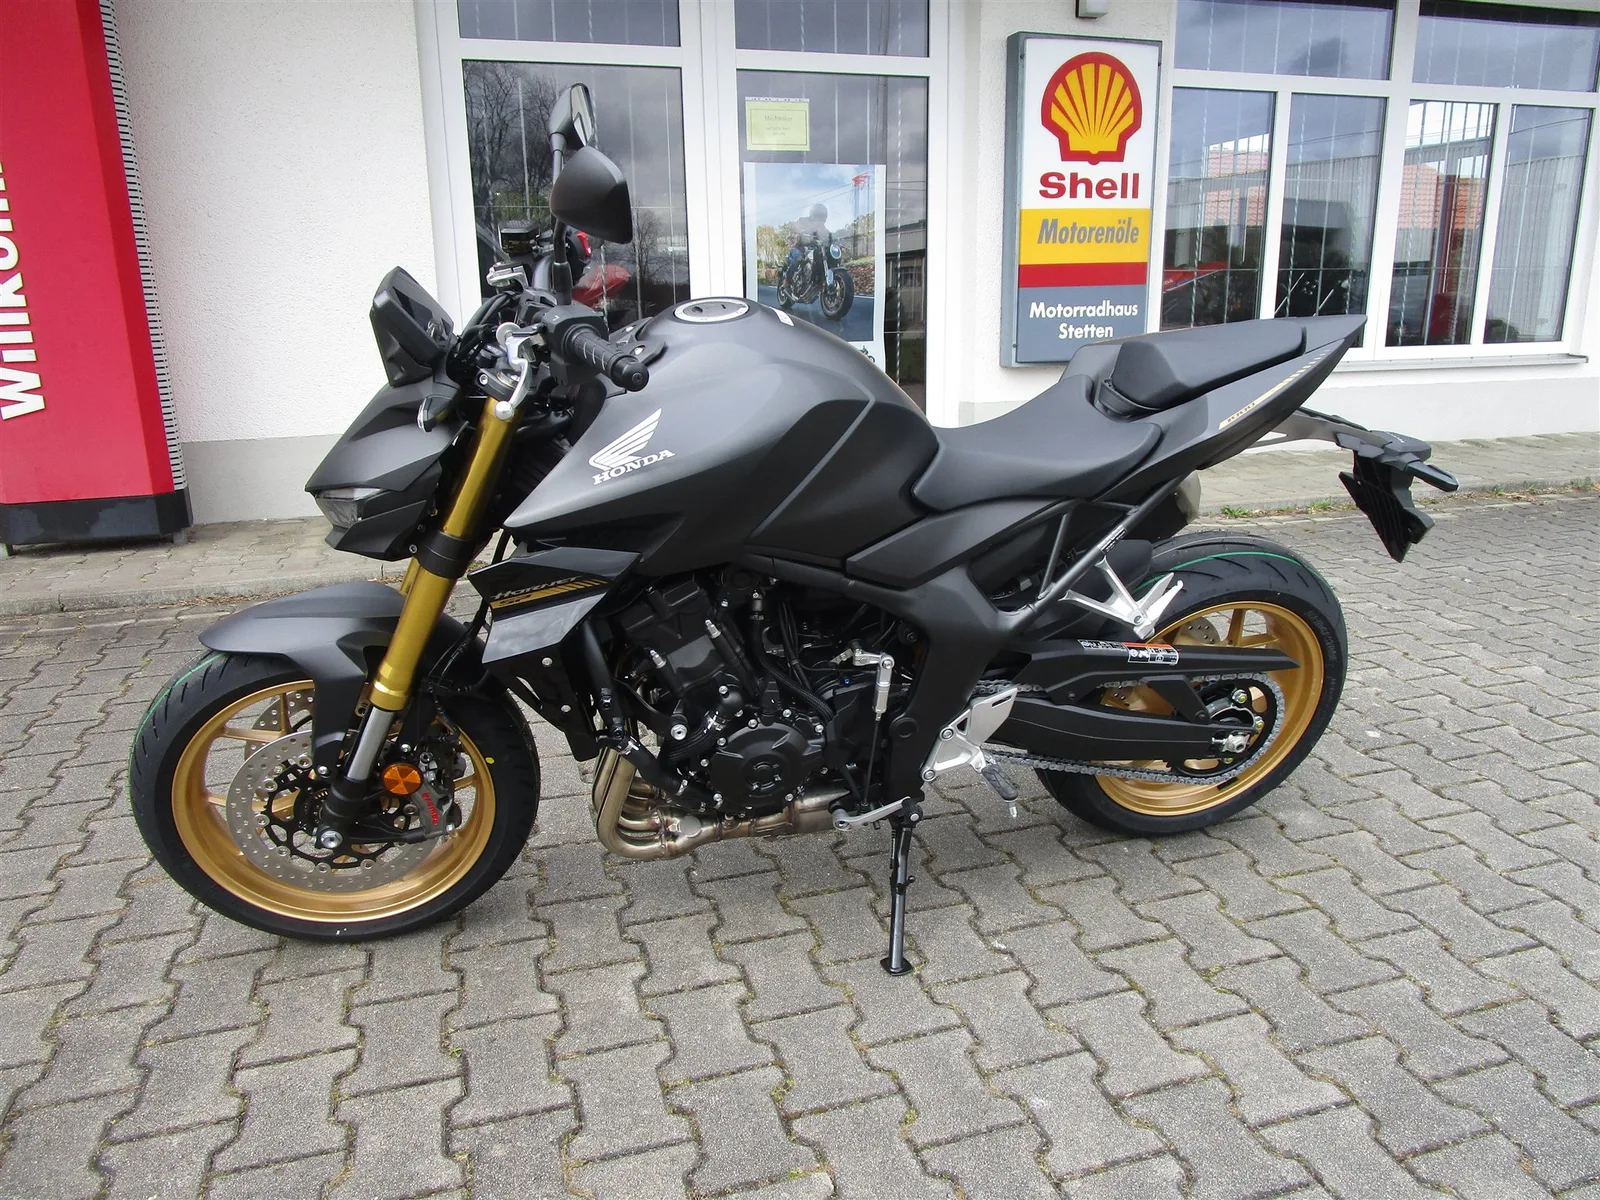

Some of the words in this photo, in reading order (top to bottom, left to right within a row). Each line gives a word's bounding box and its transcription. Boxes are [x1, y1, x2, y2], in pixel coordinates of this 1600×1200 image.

[1039, 172, 1140, 200] Shell
[1038, 217, 1139, 244] Motorenöle
[1029, 300, 1139, 319] Motorradhaus
[1058, 322, 1114, 339] Stetten
[593, 449, 676, 485] HONDA
